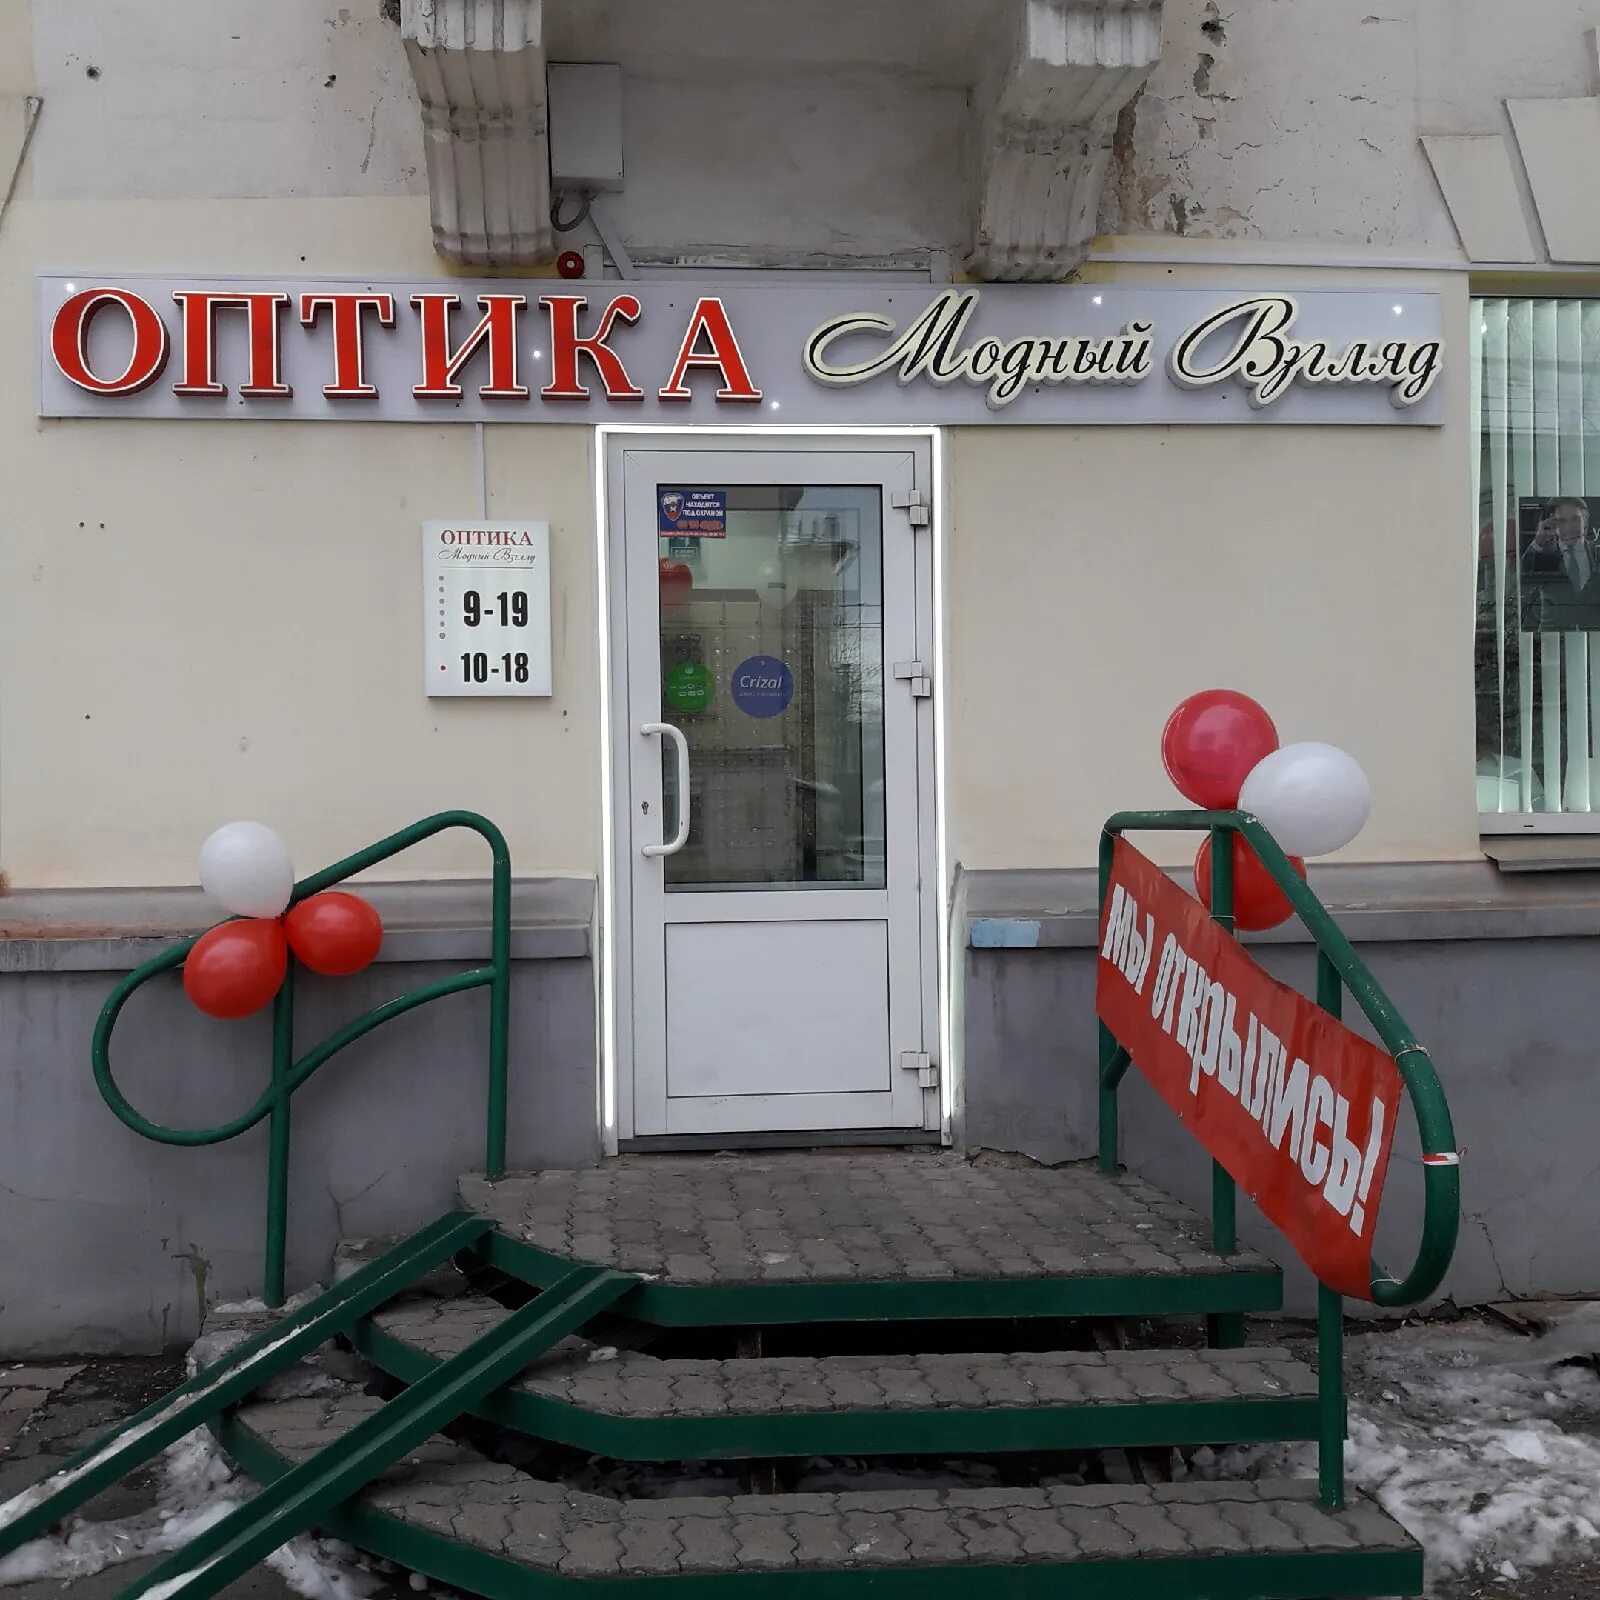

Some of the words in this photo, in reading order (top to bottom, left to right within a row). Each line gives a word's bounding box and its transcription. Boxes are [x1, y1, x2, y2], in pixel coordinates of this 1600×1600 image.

[50, 287, 763, 402] ОПТИКА
[804, 289, 1156, 405] Модный
[1172, 293, 1444, 404] Взгляд
[440, 529, 534, 546] ОПТИКА
[463, 590, 529, 628] 9-19
[460, 652, 530, 684] 10-18
[740, 675, 783, 689] Crizal
